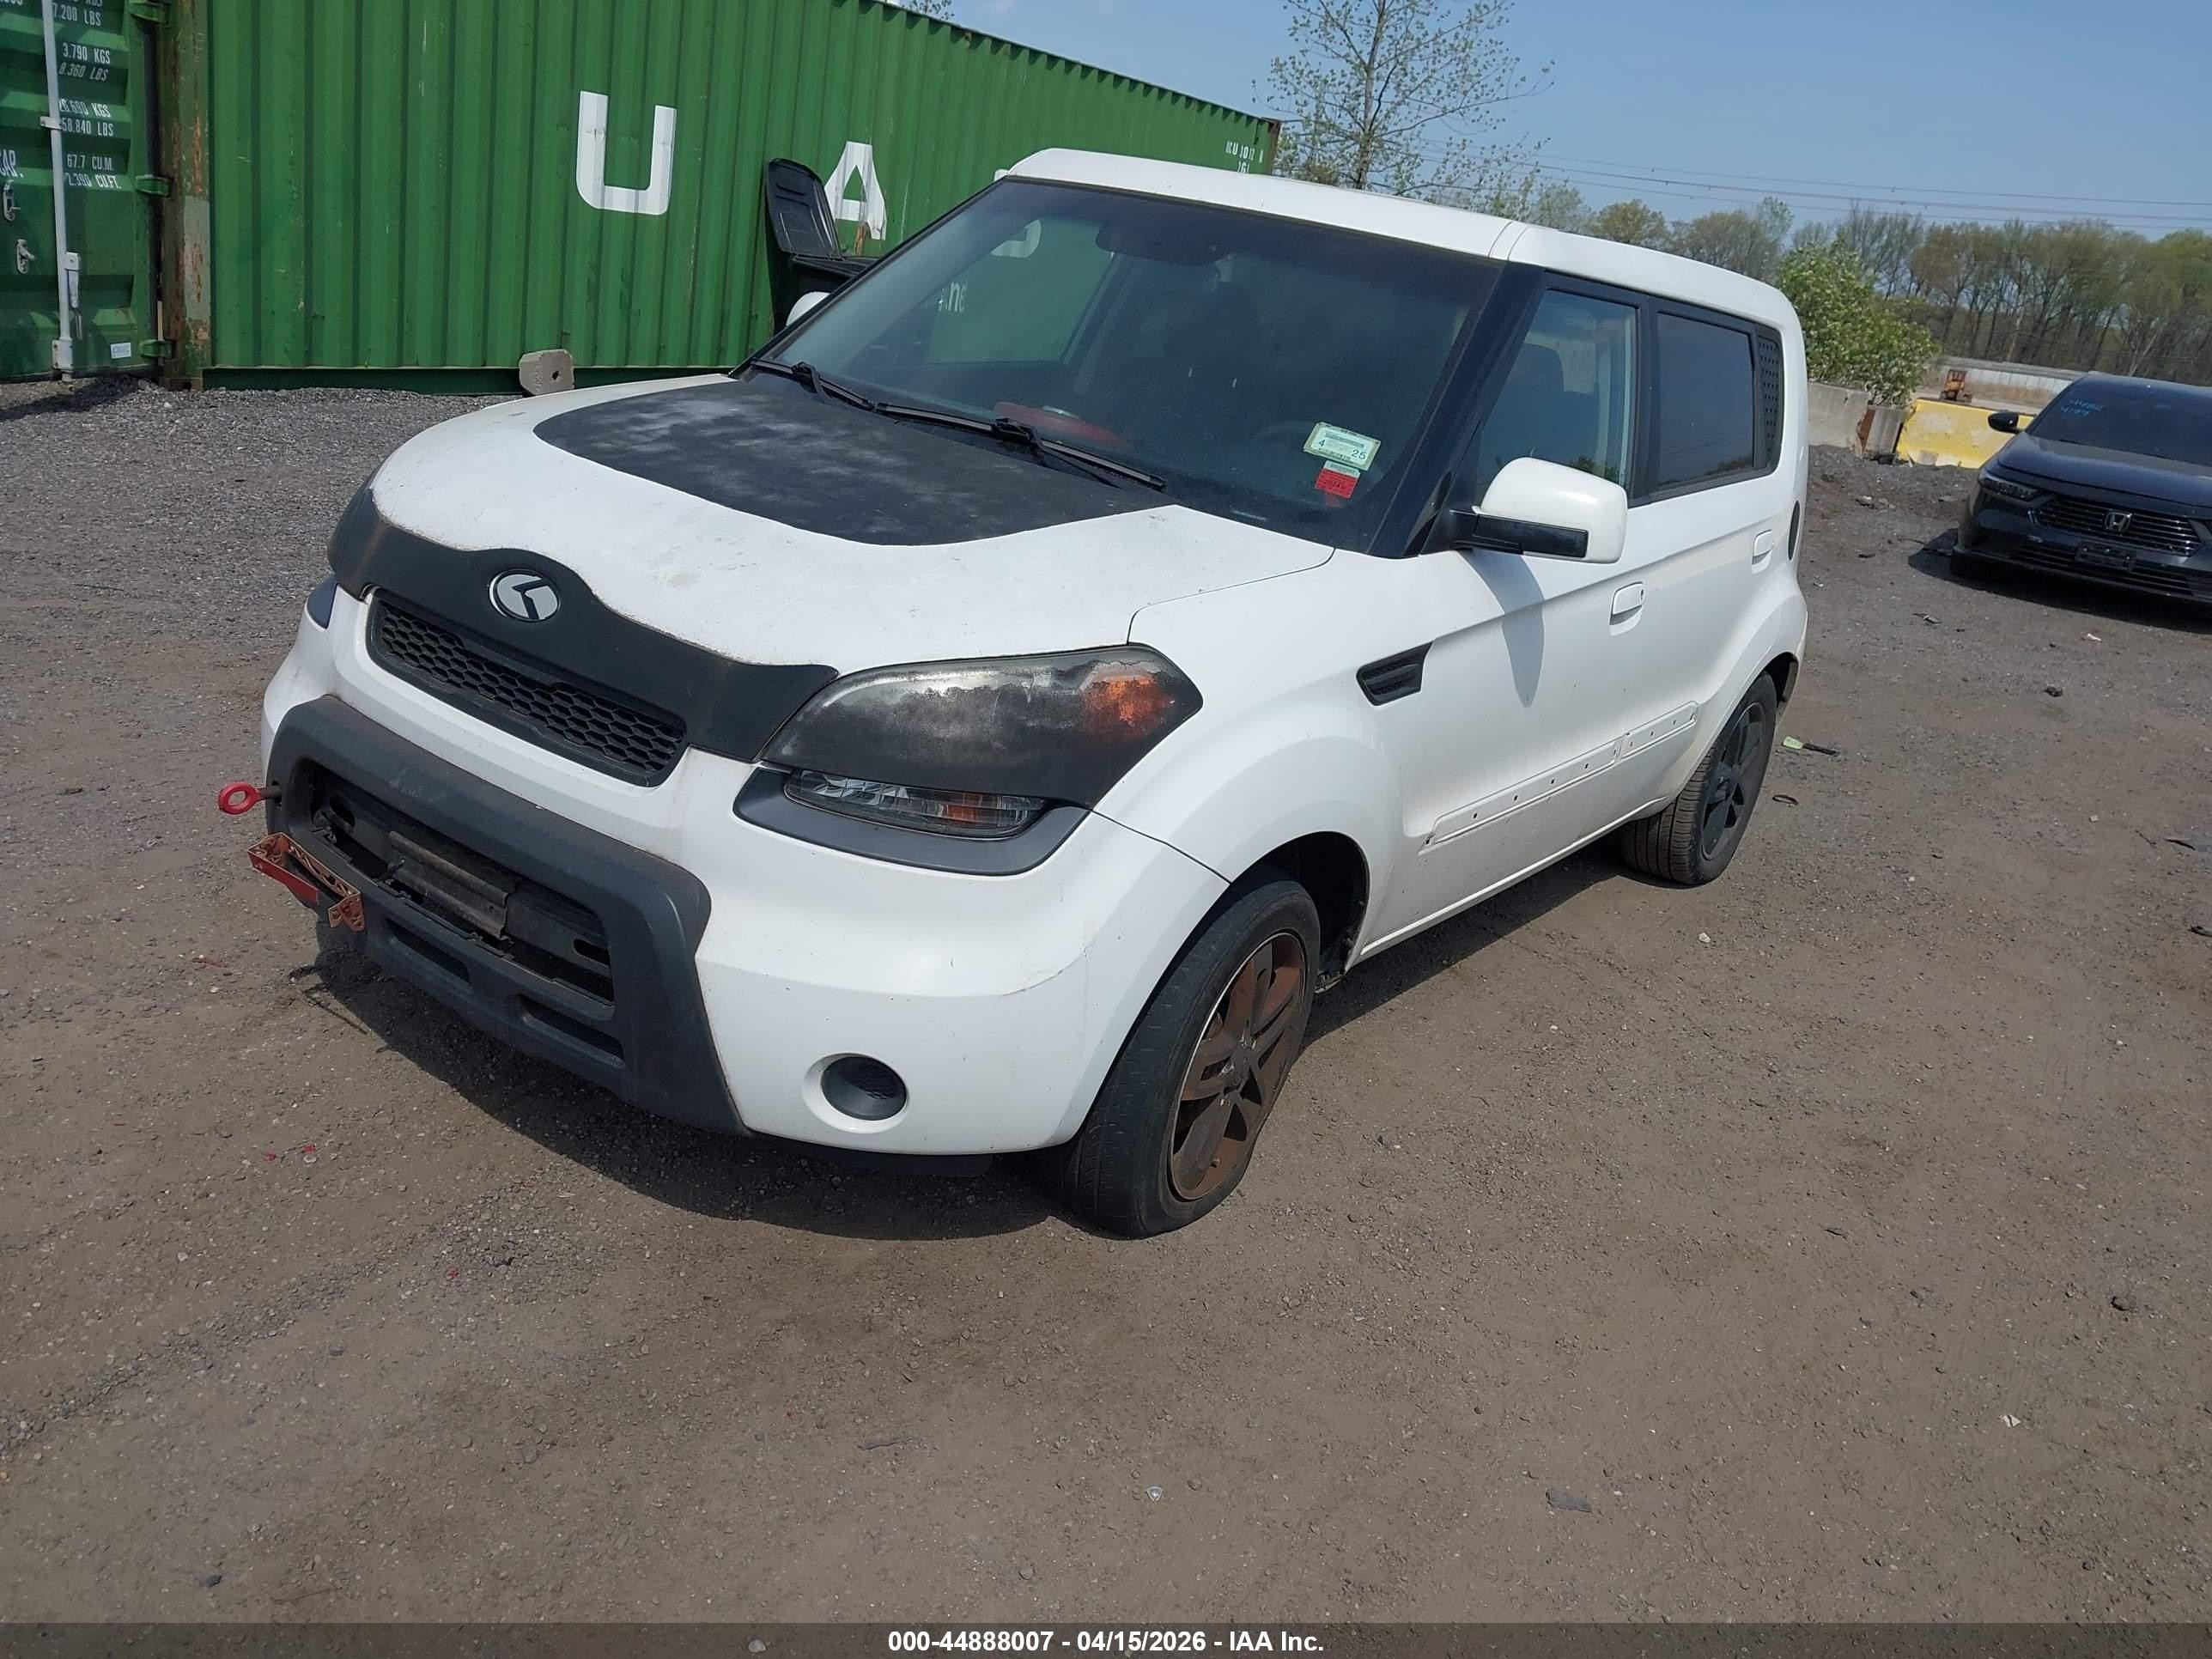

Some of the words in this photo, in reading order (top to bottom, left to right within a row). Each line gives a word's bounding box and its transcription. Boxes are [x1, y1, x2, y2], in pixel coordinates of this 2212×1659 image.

[52, 3, 77, 21] 7.200
[84, 9, 101, 27] LBS
[63, 42, 87, 61] 3.790
[94, 48, 111, 64] KGS
[58, 63, 87, 78] 8.360
[89, 67, 109, 82] LBS
[91, 102, 111, 118] KGS
[62, 118, 91, 134] 58.840
[97, 121, 113, 137] LBS
[67, 154, 86, 168] 67.7
[1318, 439, 1326, 447] 4
[1351, 449, 1368, 460] 25
